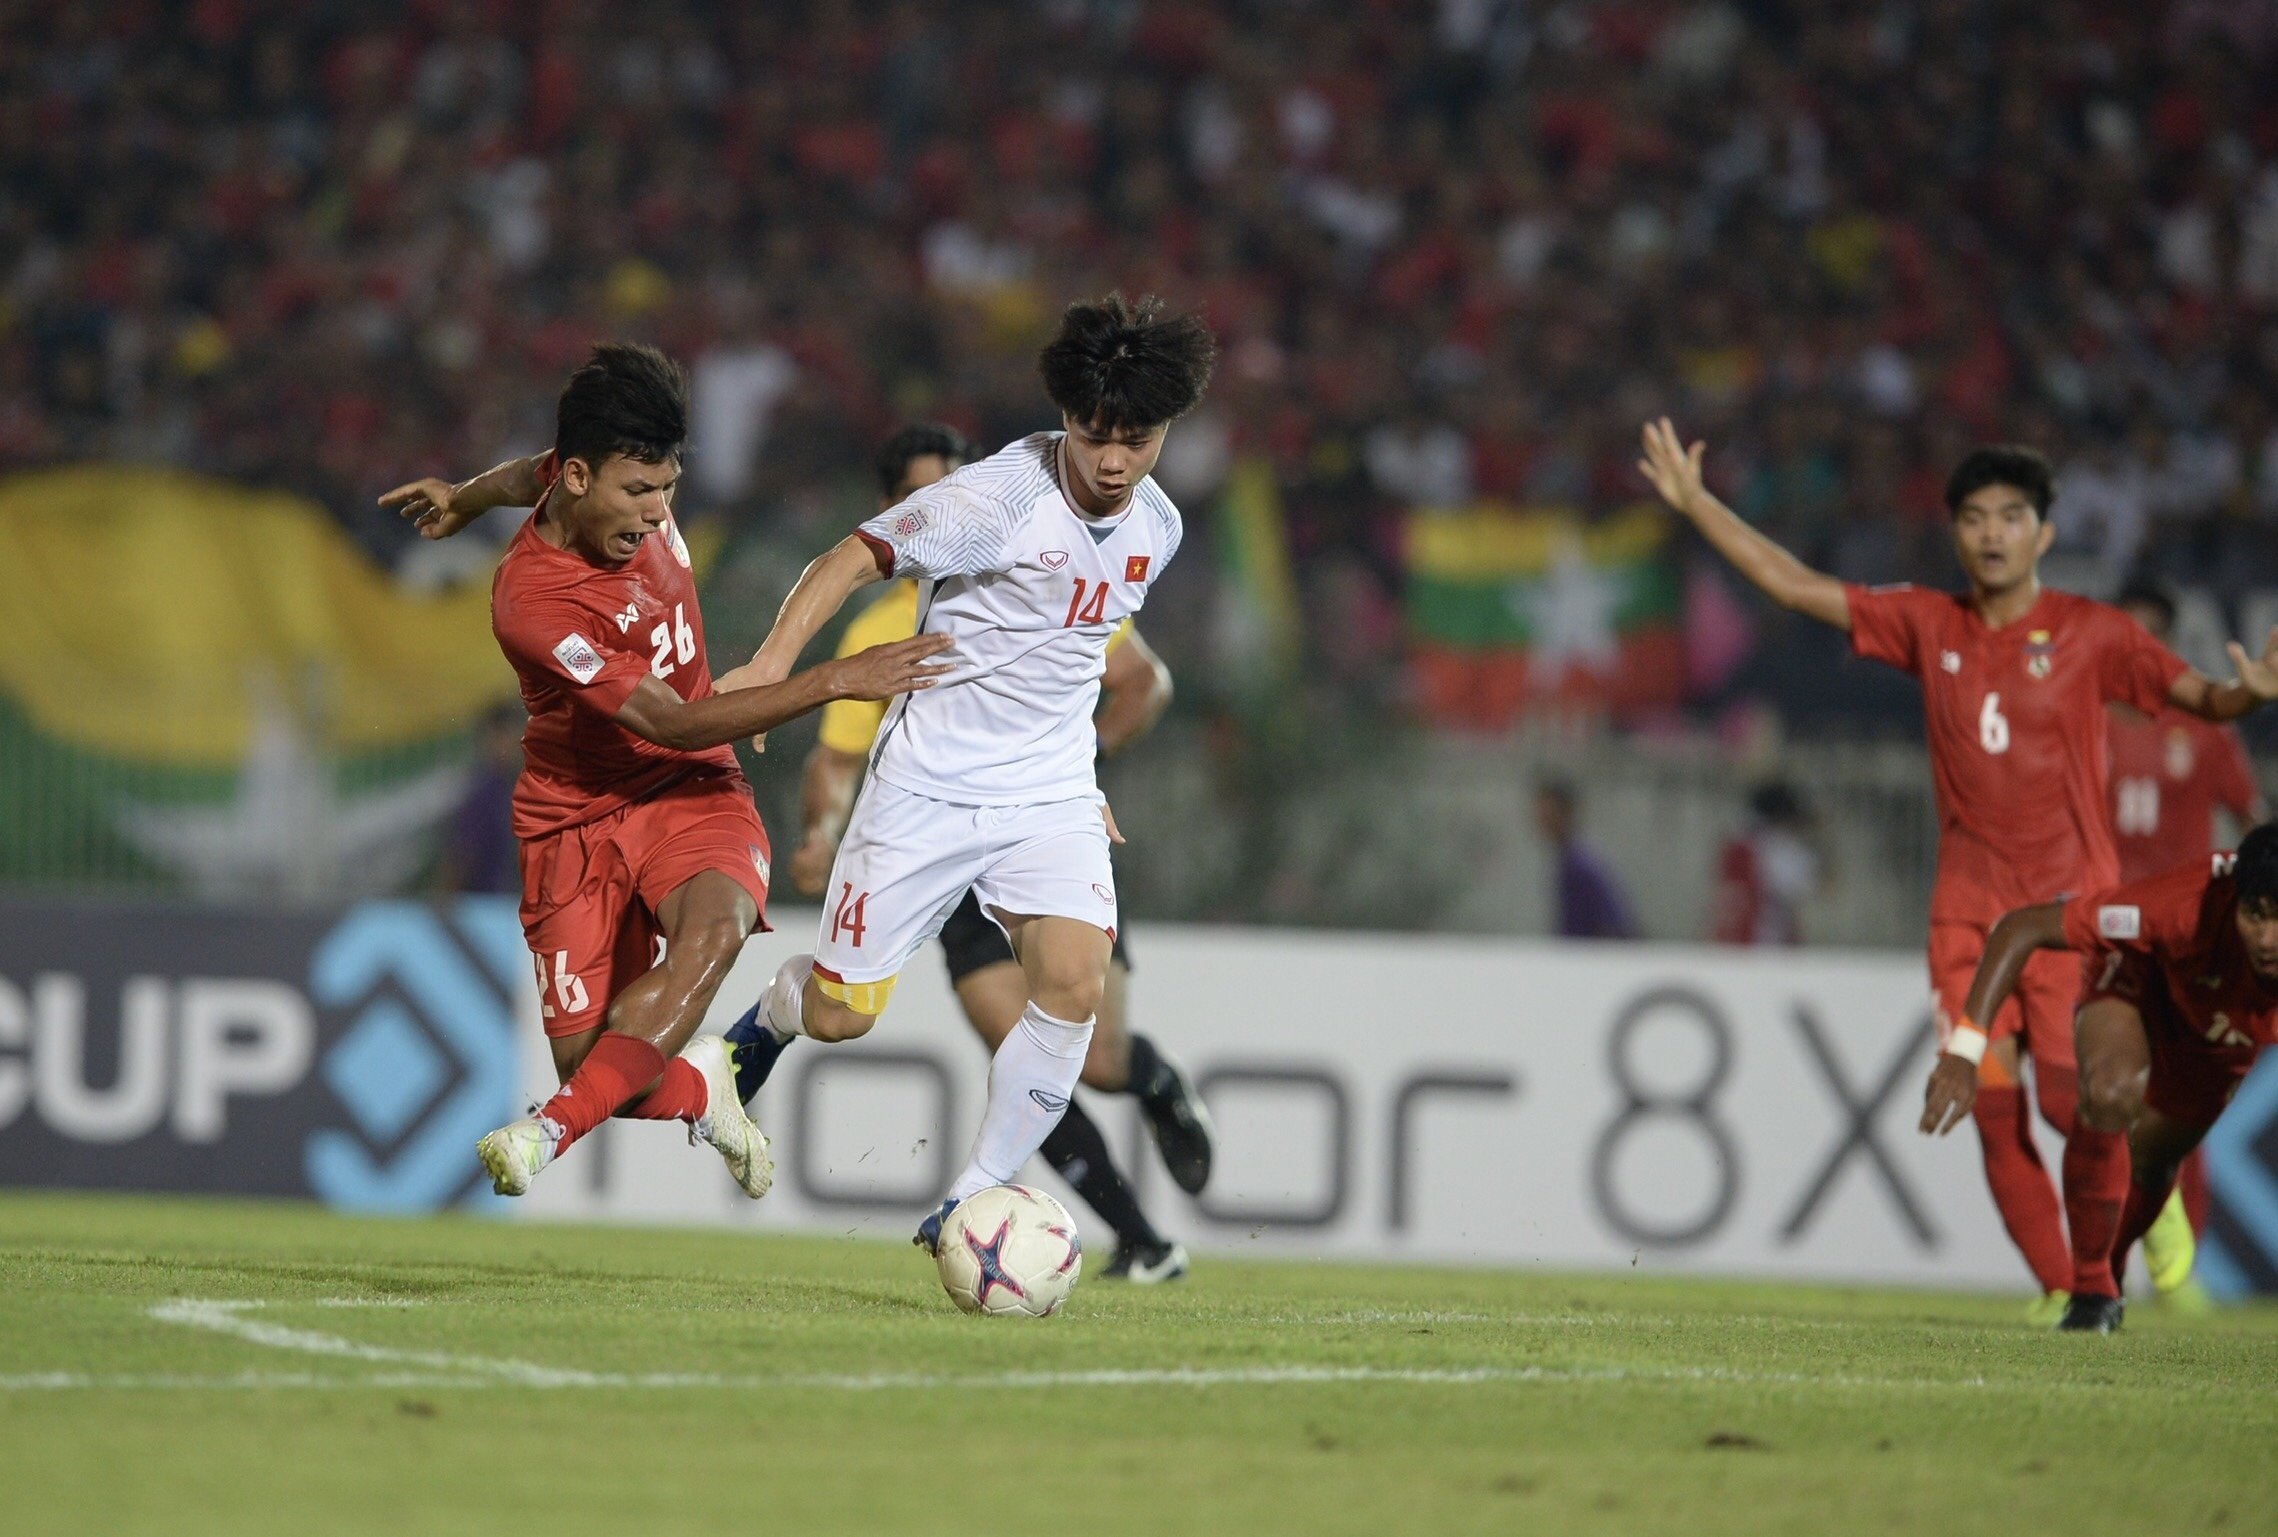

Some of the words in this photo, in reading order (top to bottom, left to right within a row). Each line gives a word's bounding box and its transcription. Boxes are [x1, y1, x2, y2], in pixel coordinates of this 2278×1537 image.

[1064, 577, 1110, 629] 14
[650, 602, 696, 680] 26
[1979, 691, 2010, 755] 6
[831, 881, 870, 948] 14
[0, 970, 318, 1144] UP
[1586, 983, 1946, 1254] 8X
